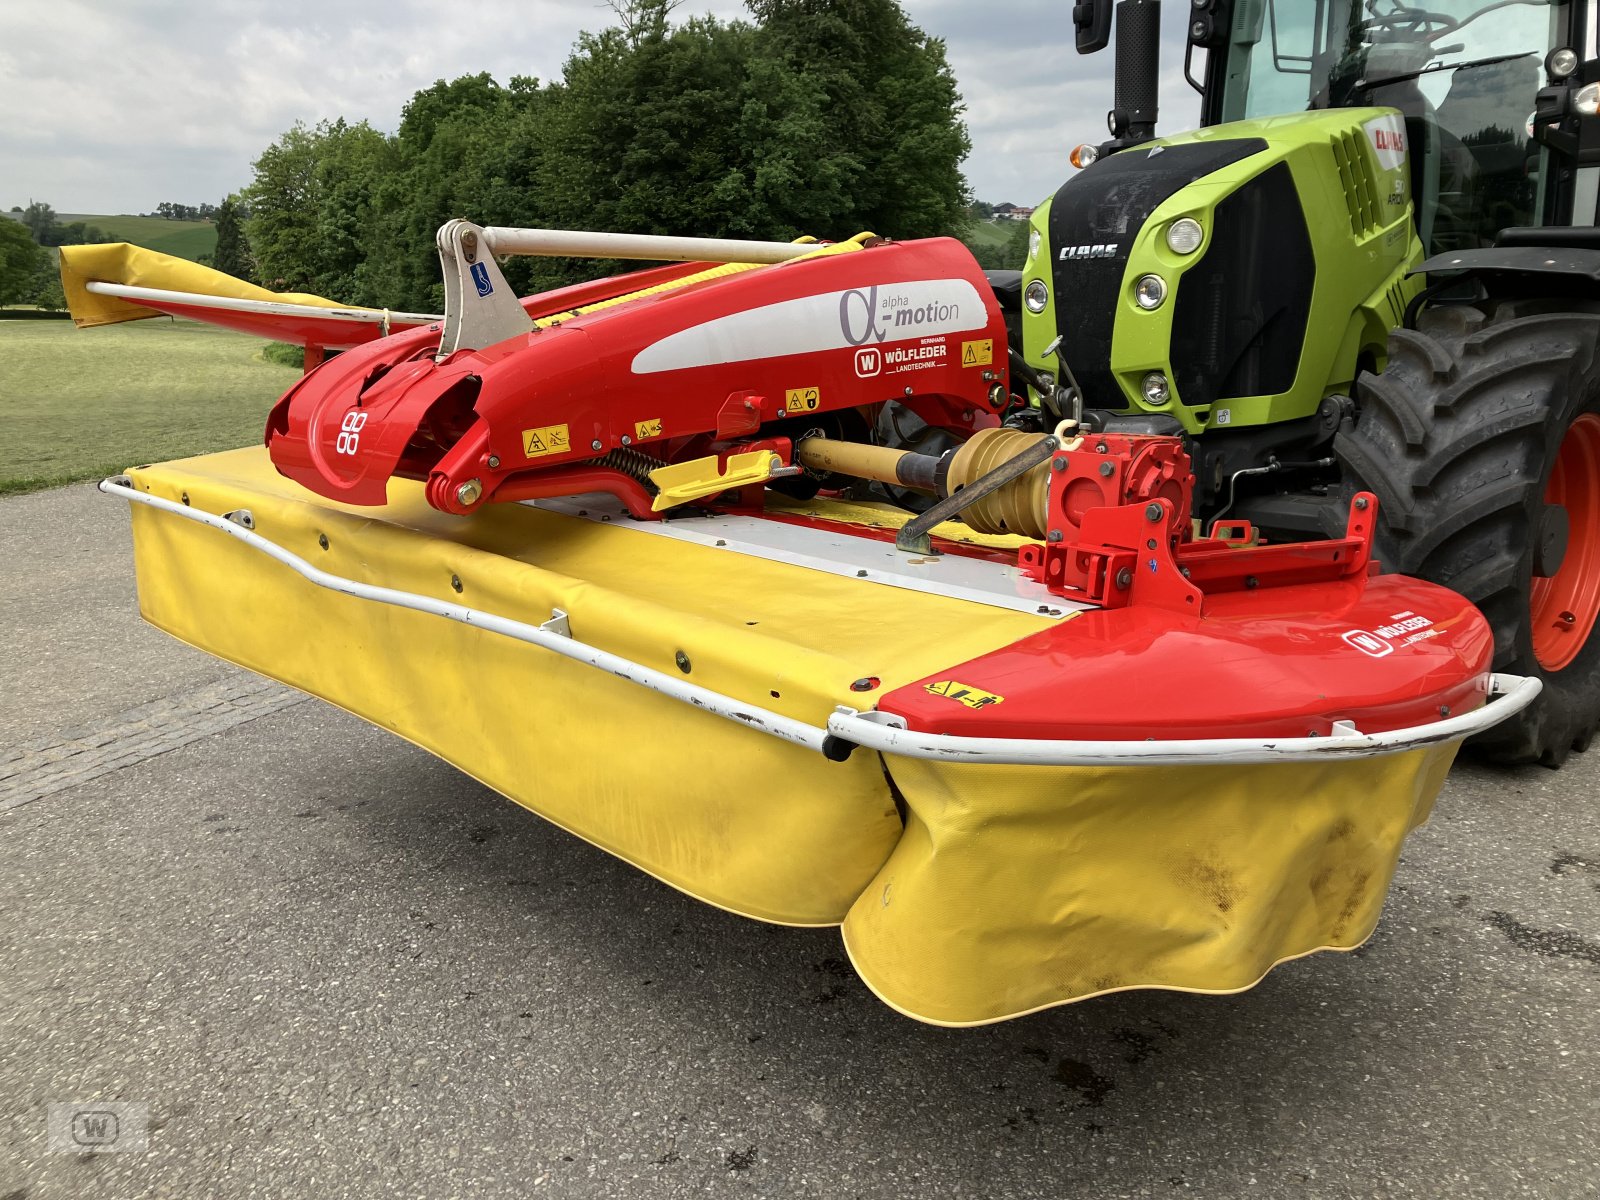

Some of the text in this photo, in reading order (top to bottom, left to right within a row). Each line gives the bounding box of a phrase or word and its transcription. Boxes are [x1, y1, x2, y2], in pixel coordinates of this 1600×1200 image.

[1059, 244, 1118, 260] CLAAS
[882, 295, 909, 310] alpha
[920, 336, 946, 345] BERNHARD
[885, 345, 947, 364] WÖLFLEDER
[860, 354, 875, 371] W
[895, 361, 936, 373] LANDTECHNIK
